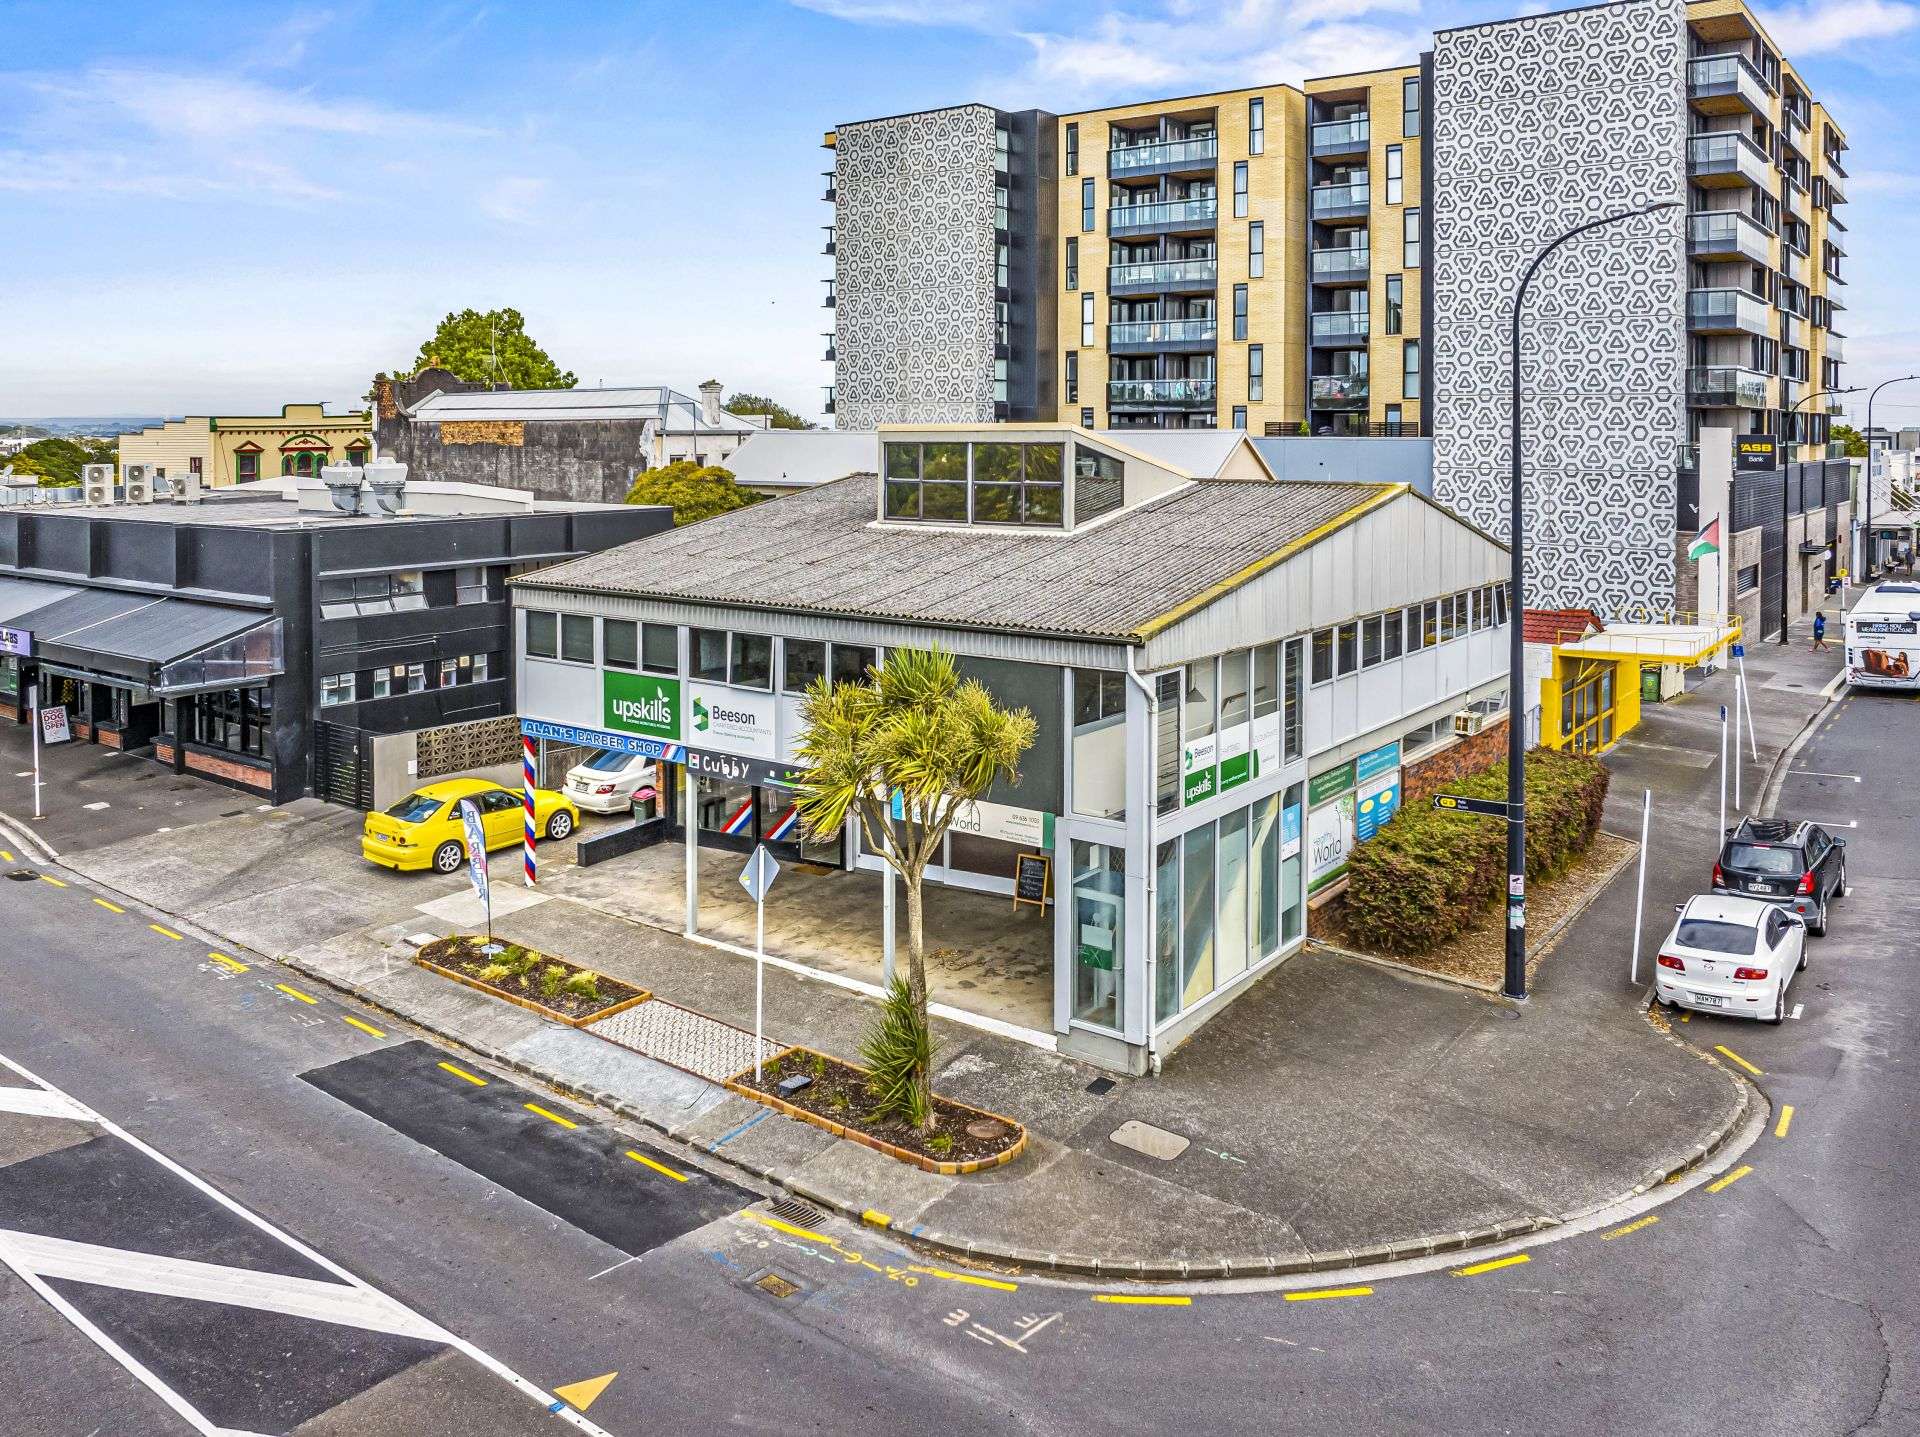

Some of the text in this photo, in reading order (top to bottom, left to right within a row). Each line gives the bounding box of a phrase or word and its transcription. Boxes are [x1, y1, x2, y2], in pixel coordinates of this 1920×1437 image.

[1741, 443, 1772, 452] ASB
[44, 713, 64, 721] DOG
[613, 697, 671, 723] upskills
[712, 705, 755, 725] Beeson
[576, 730, 625, 749] BARBER
[628, 740, 662, 754] SHOP
[1194, 745, 1214, 758] Beeson
[703, 755, 750, 779] Cubby
[1187, 777, 1212, 801] upskills
[949, 808, 981, 832] World
[1313, 838, 1342, 866] World
